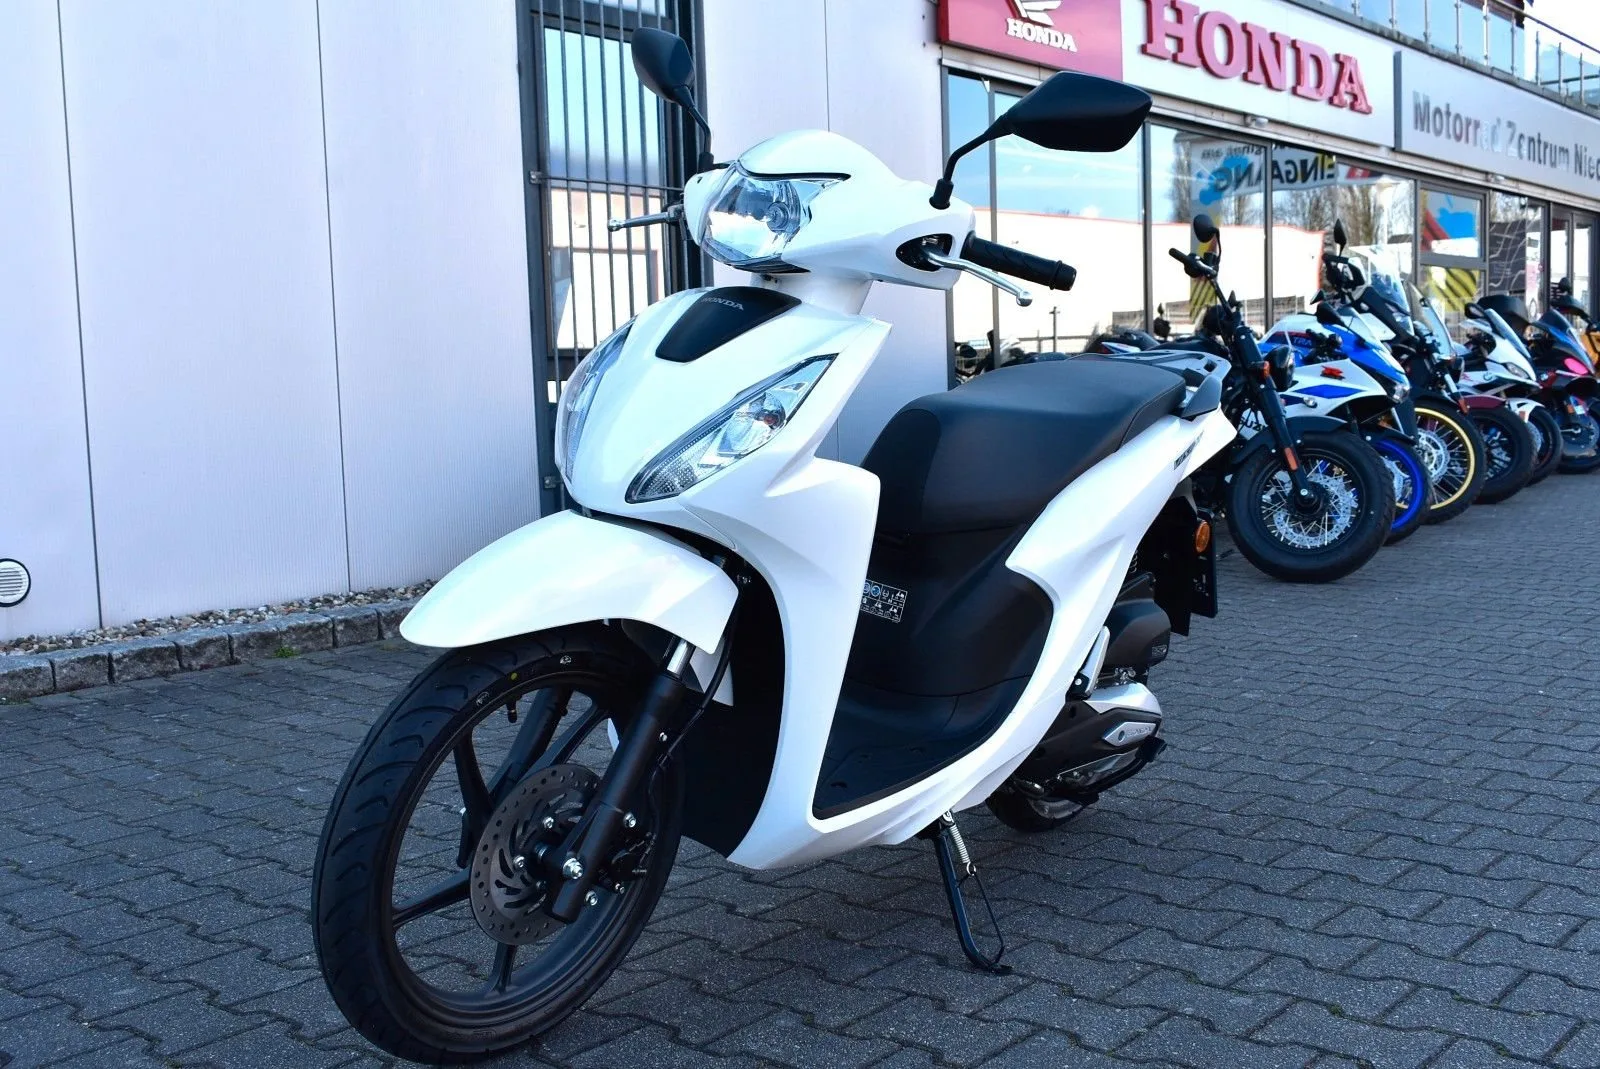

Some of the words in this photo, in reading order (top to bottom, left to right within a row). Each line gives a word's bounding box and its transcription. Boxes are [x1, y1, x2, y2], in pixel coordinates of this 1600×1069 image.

[1006, 18, 1078, 52] HONDA
[1141, 0, 1372, 114] HONDA
[1506, 120, 1569, 171] Zentrum
[702, 297, 744, 311] HONDA
